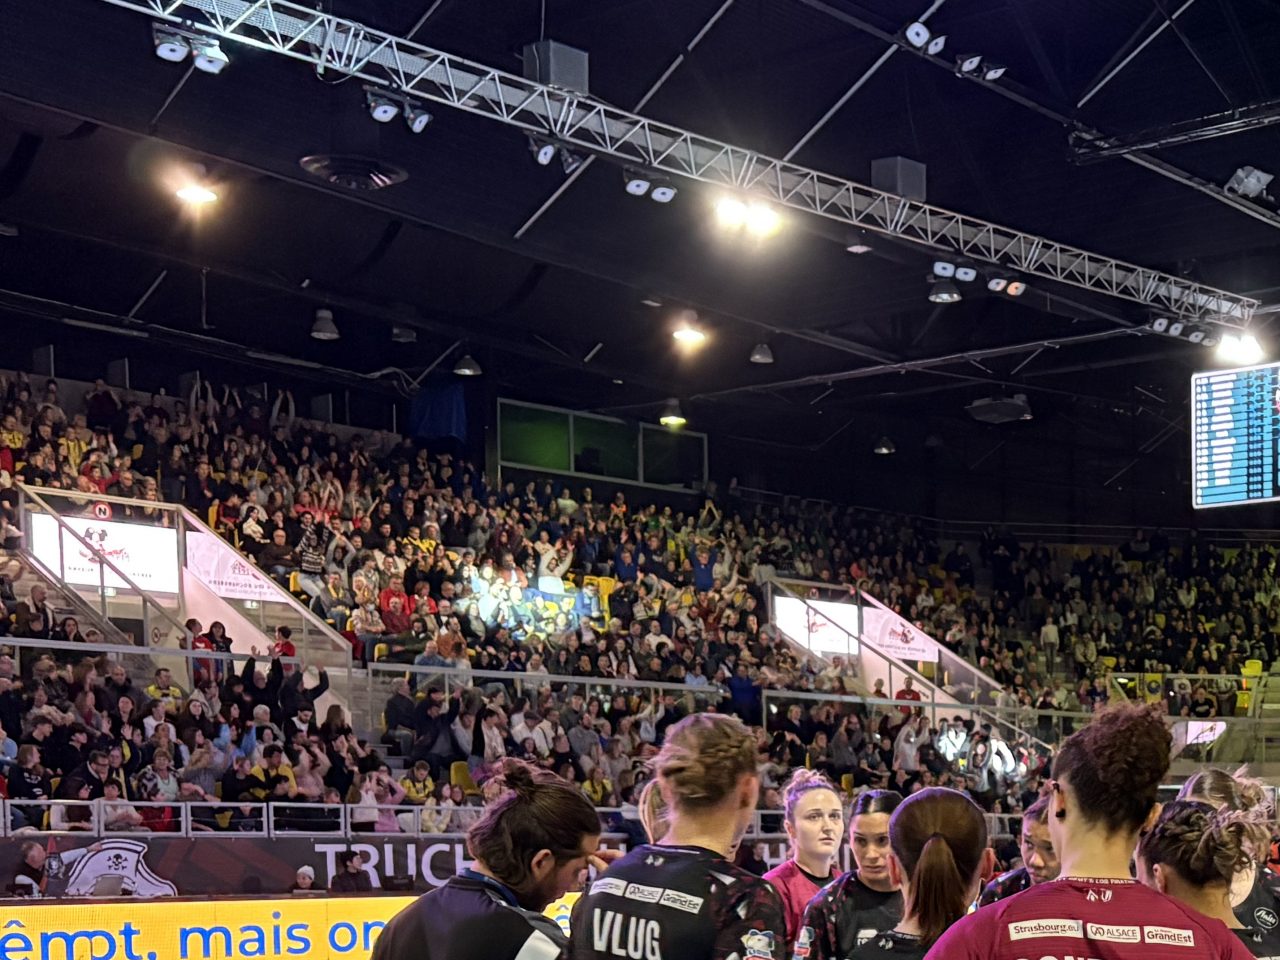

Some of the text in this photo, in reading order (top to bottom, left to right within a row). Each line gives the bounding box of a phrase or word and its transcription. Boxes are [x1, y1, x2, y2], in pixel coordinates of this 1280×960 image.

[179, 911, 311, 959] mais
[1014, 920, 1079, 935] Strasbourg.eu
[1106, 928, 1138, 937] ALSACE
